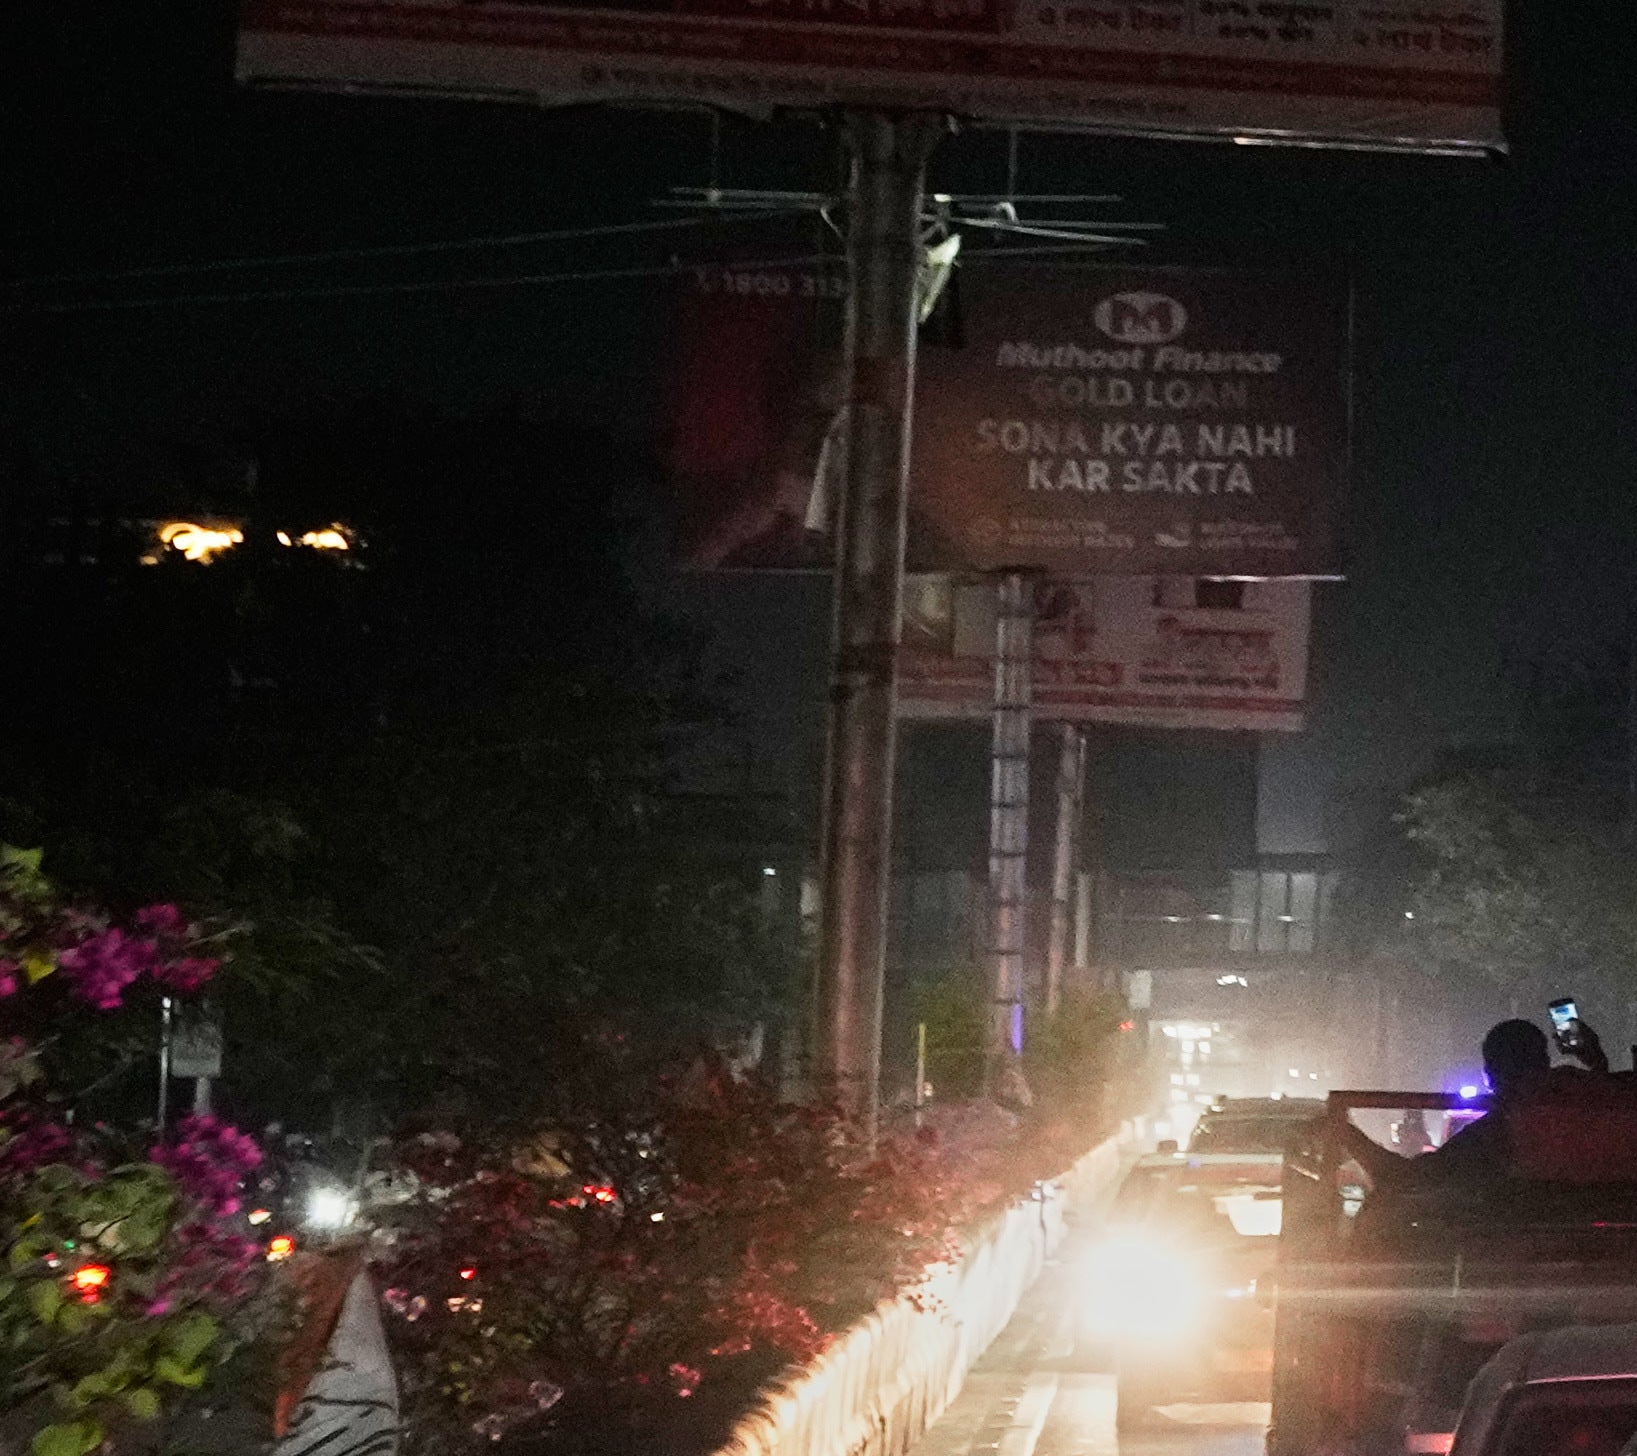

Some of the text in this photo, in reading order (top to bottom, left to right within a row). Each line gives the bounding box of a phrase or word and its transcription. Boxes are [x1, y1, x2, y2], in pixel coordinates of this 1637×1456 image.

[996, 340, 1284, 375] Muthoot Finance
[1028, 377, 1249, 410] GOLD LOAN
[975, 419, 1296, 458] SONA KYA NAHI
[1027, 458, 1254, 496] KAR SAKTA
